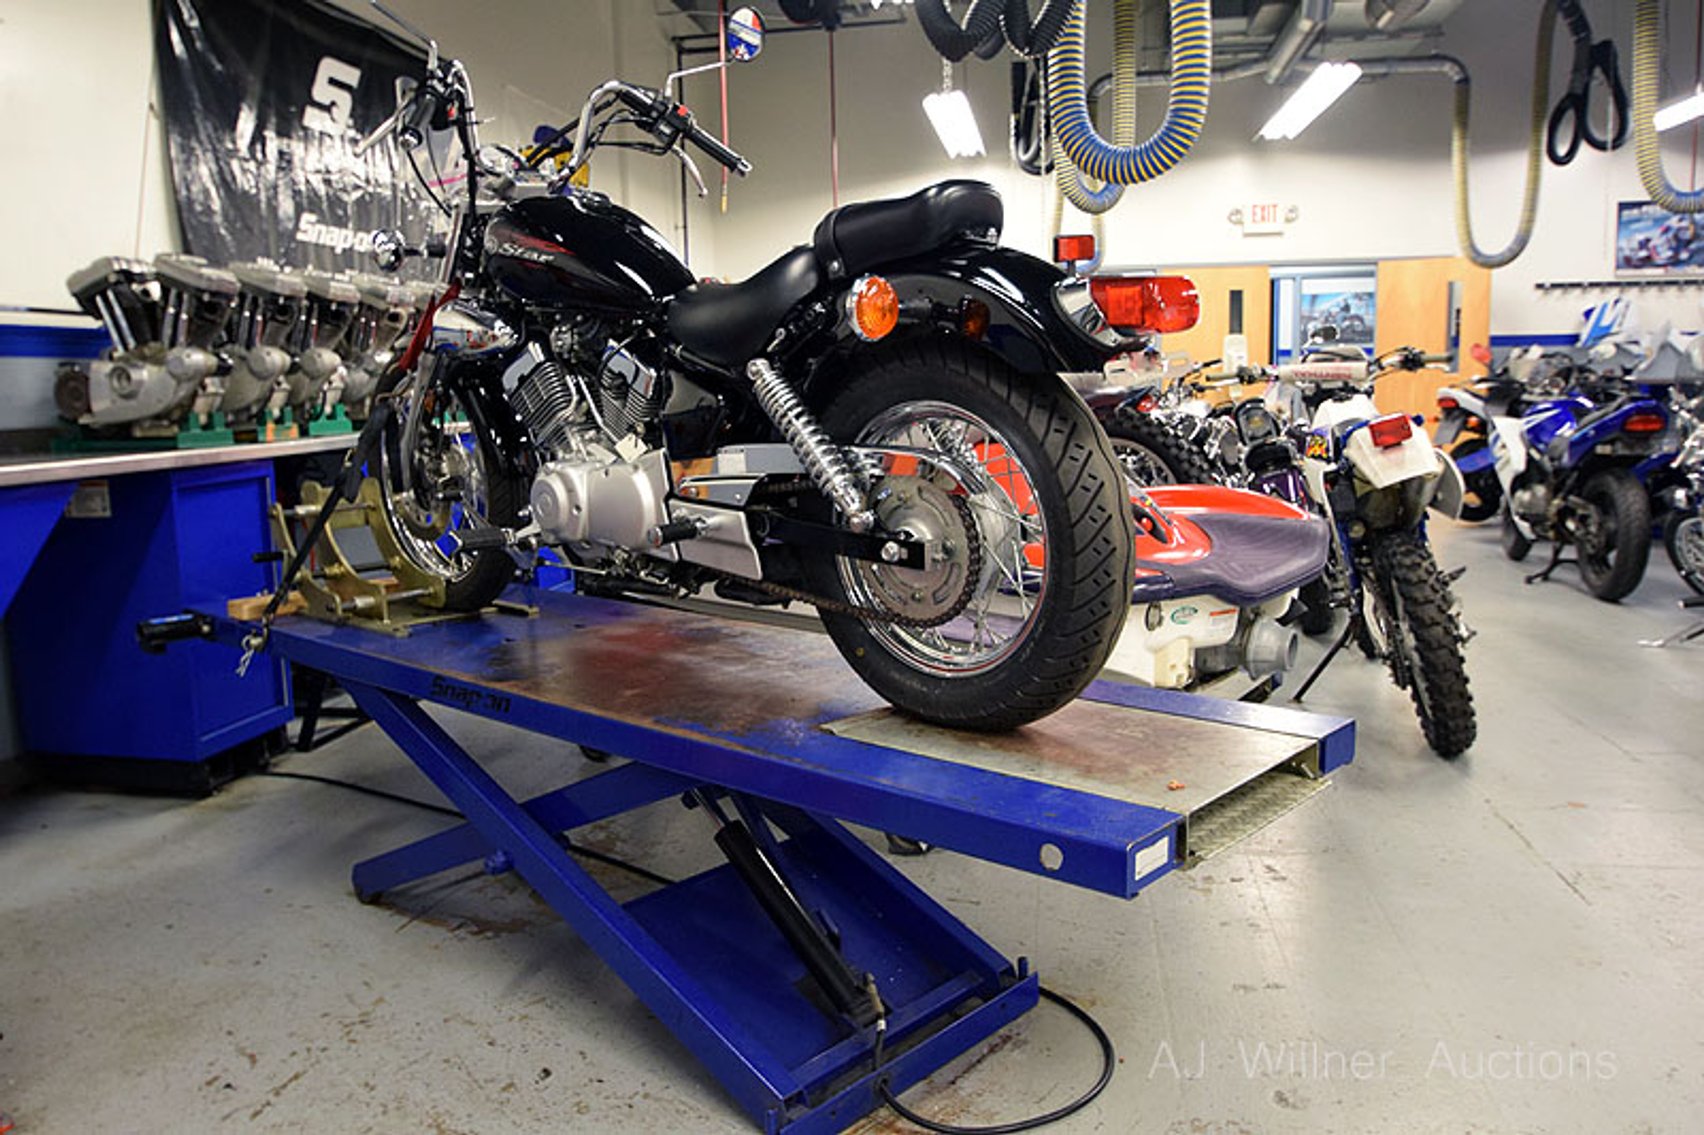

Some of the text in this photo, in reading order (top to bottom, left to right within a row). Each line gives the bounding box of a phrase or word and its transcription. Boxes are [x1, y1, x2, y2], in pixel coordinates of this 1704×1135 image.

[1252, 204, 1278, 223] EXIT
[296, 212, 374, 254] Snap-o
[499, 243, 555, 263] Star
